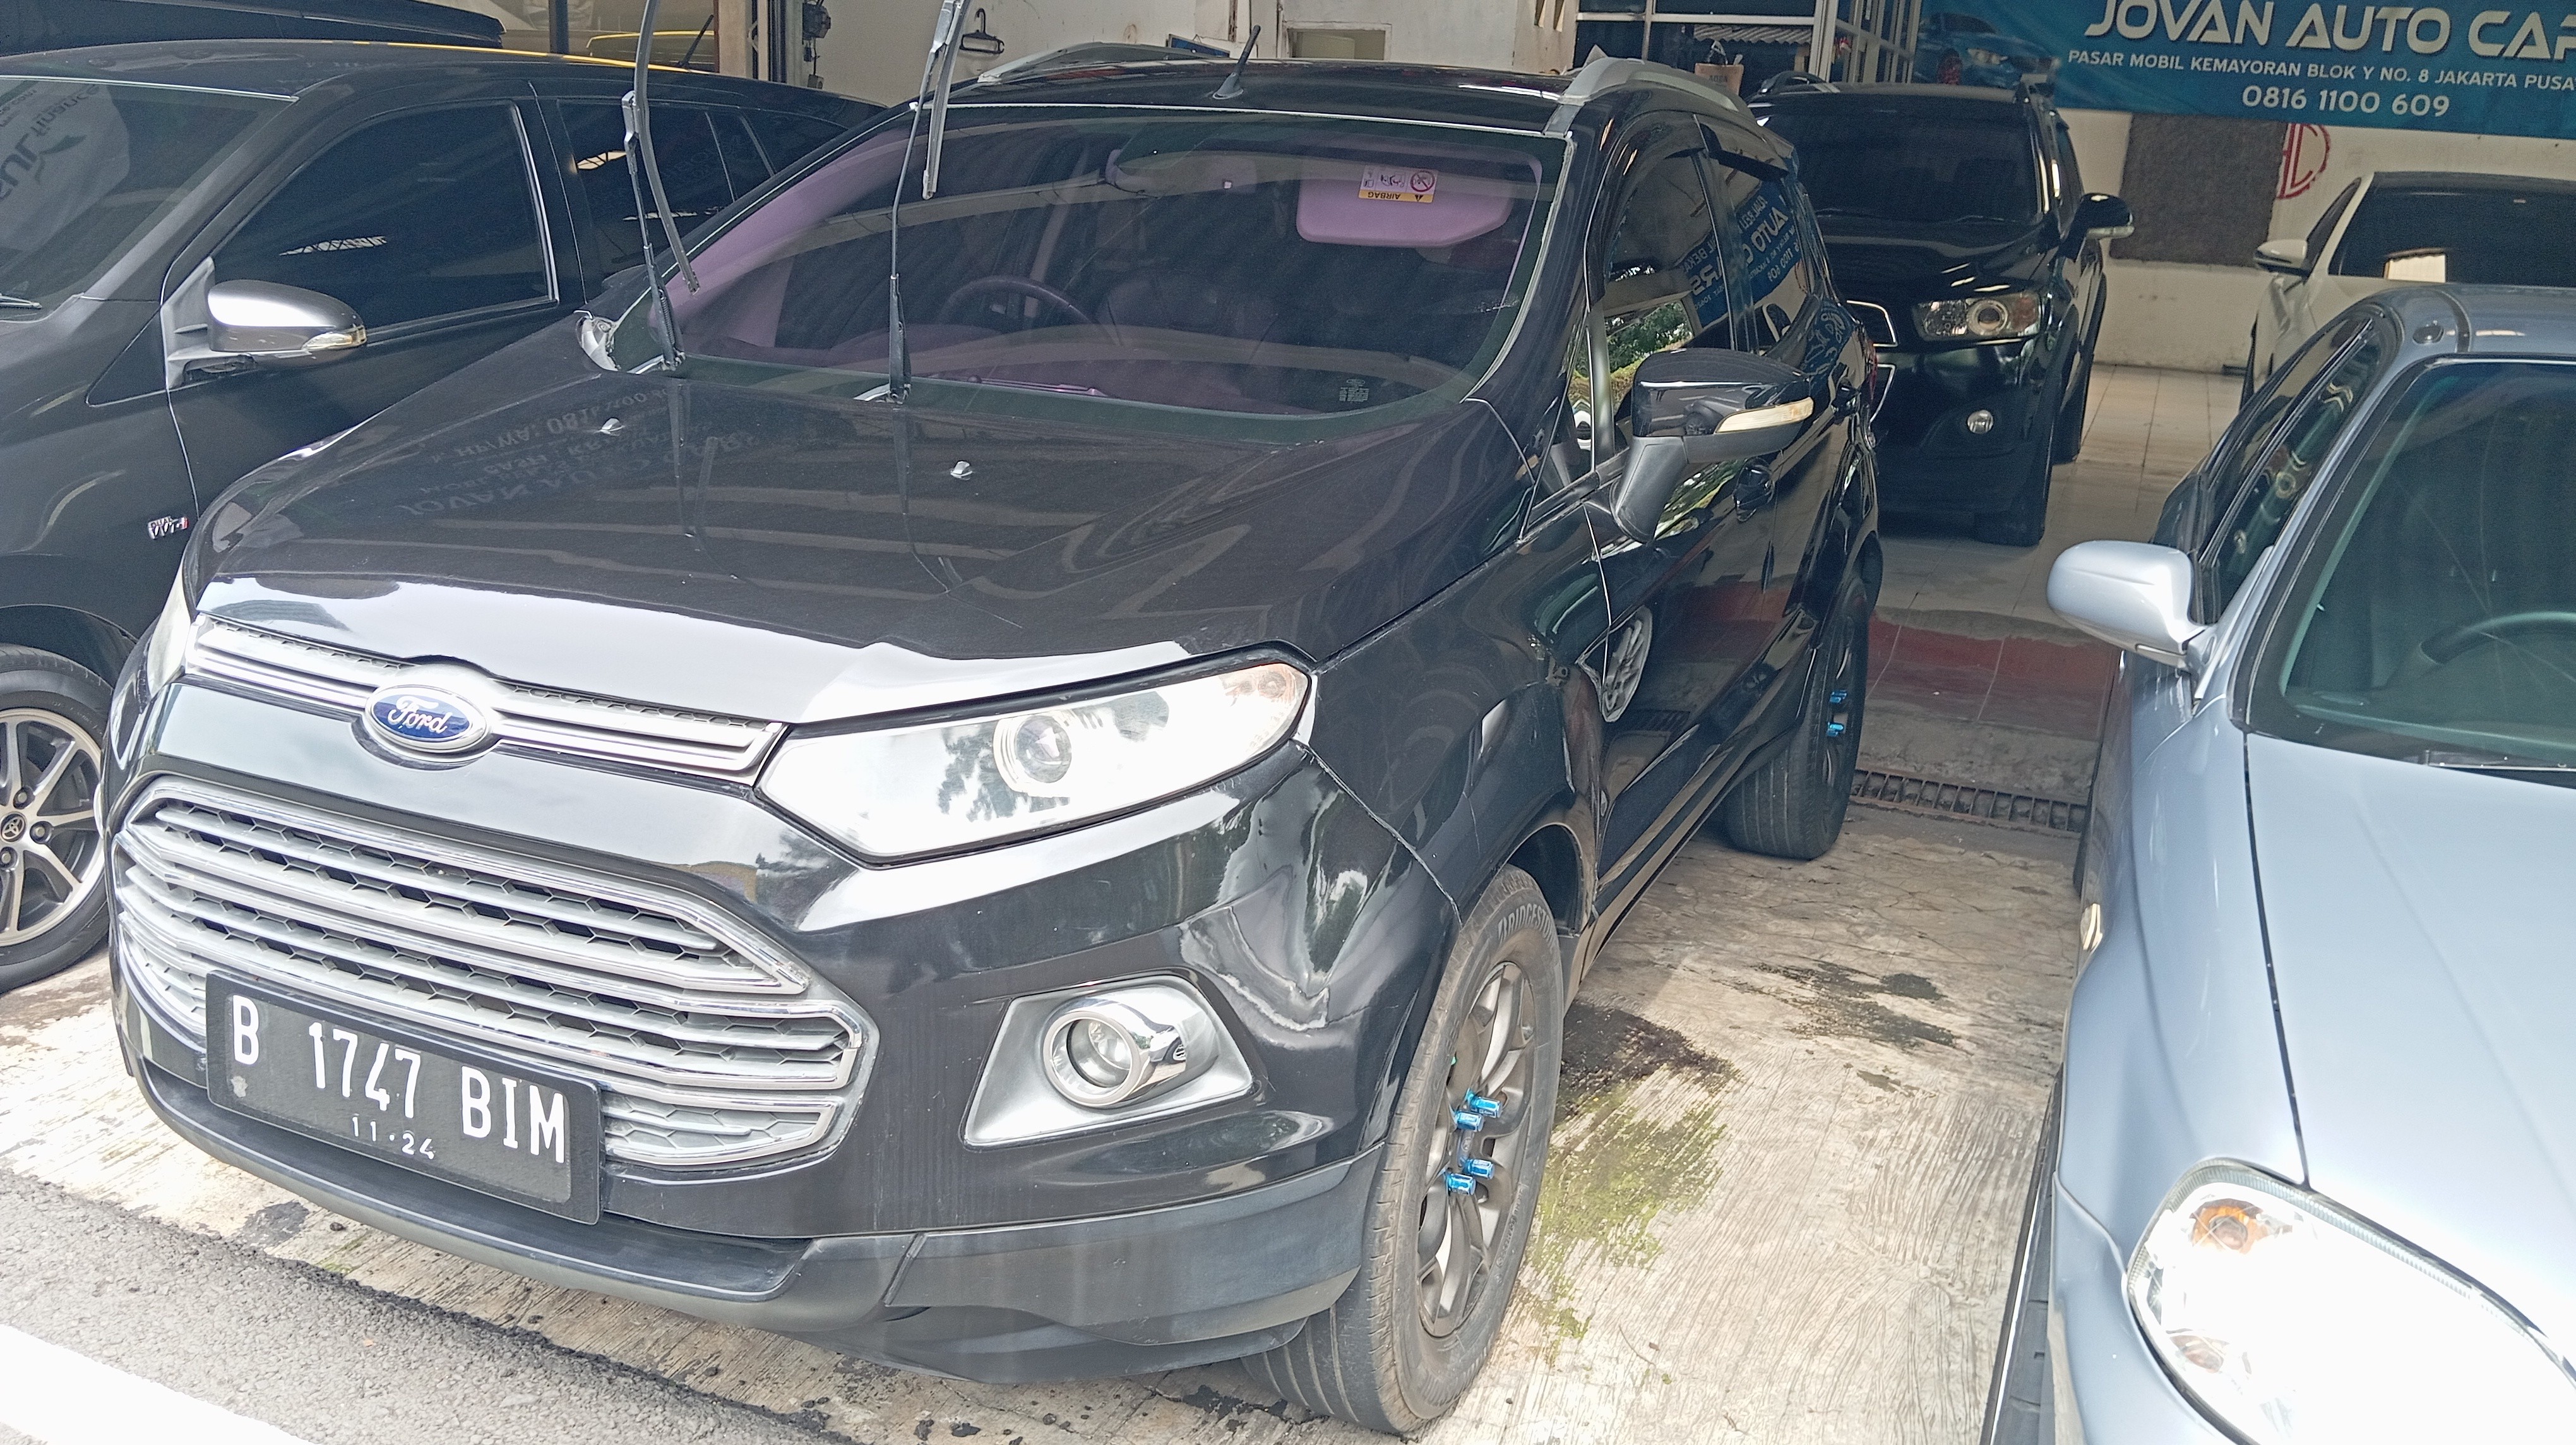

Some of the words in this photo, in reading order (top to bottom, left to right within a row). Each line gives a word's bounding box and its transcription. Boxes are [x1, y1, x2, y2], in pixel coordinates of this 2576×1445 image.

[2084, 0, 2274, 46] JOVAN
[2286, 3, 2451, 54] AUTO
[2068, 50, 2124, 66] PASAR
[2130, 54, 2184, 70] MOBIL
[2190, 57, 2301, 76] KEMAYORAN
[2307, 64, 2356, 80] BLOK
[2363, 66, 2375, 80] Y
[2380, 68, 2411, 82] NO.
[2418, 69, 2429, 83] 8
[2435, 70, 2517, 87] JAKARTA
[2524, 74, 2576, 90] PUSA
[2243, 85, 2306, 110] 0816
[2319, 90, 2380, 113] 1100
[2392, 93, 2450, 117] 609
[1368, 191, 1401, 200] AIRBAG
[388, 696, 453, 734] Ford
[233, 995, 259, 1065] B
[309, 1022, 421, 1118] 1747
[461, 1065, 564, 1163] BIM
